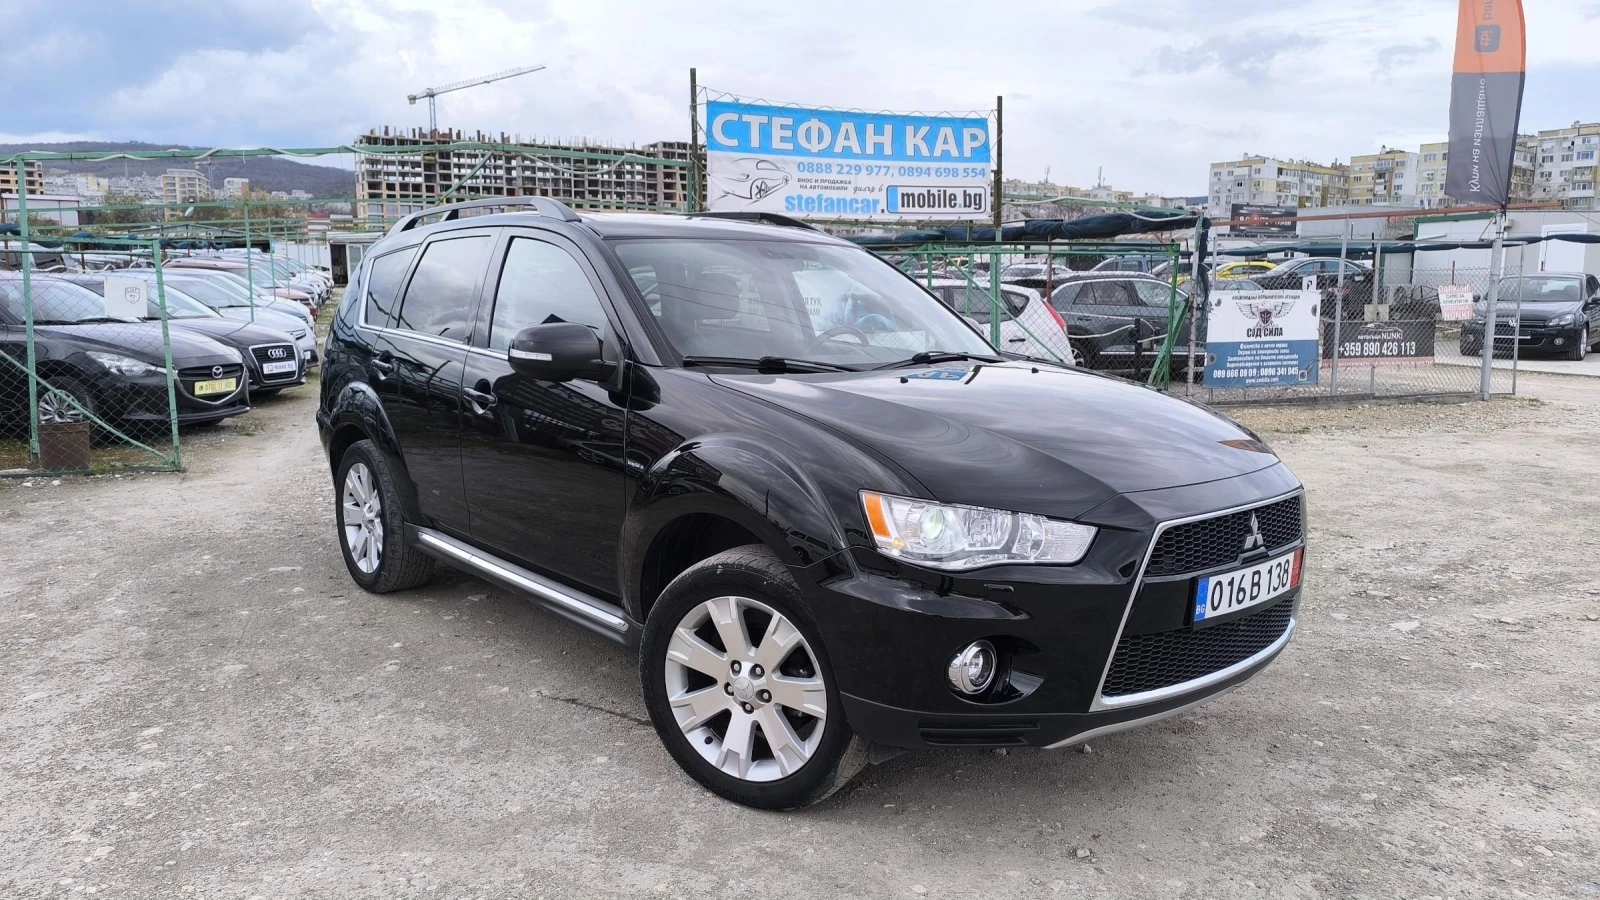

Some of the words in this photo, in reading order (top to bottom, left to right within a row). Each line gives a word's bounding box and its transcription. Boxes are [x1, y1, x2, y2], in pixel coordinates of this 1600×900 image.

[712, 112, 893, 156] СТЕФАН
[905, 125, 987, 158] КАР
[797, 162, 833, 174] 0888
[836, 164, 862, 176] 229
[865, 165, 894, 178] 977,
[898, 166, 932, 178] 0894
[935, 167, 959, 178] 698
[963, 168, 986, 178] 554
[900, 189, 983, 210] mobile.bg
[1263, 327, 1283, 337] СИЛА
[1338, 342, 1361, 356] +359
[1363, 342, 1380, 356] 890
[1381, 341, 1398, 355] 426
[1400, 341, 1416, 355] 113
[1210, 574, 1247, 612] 016
[1249, 569, 1262, 601] B
[1266, 558, 1290, 596] 138
[1195, 603, 1206, 615] BG
